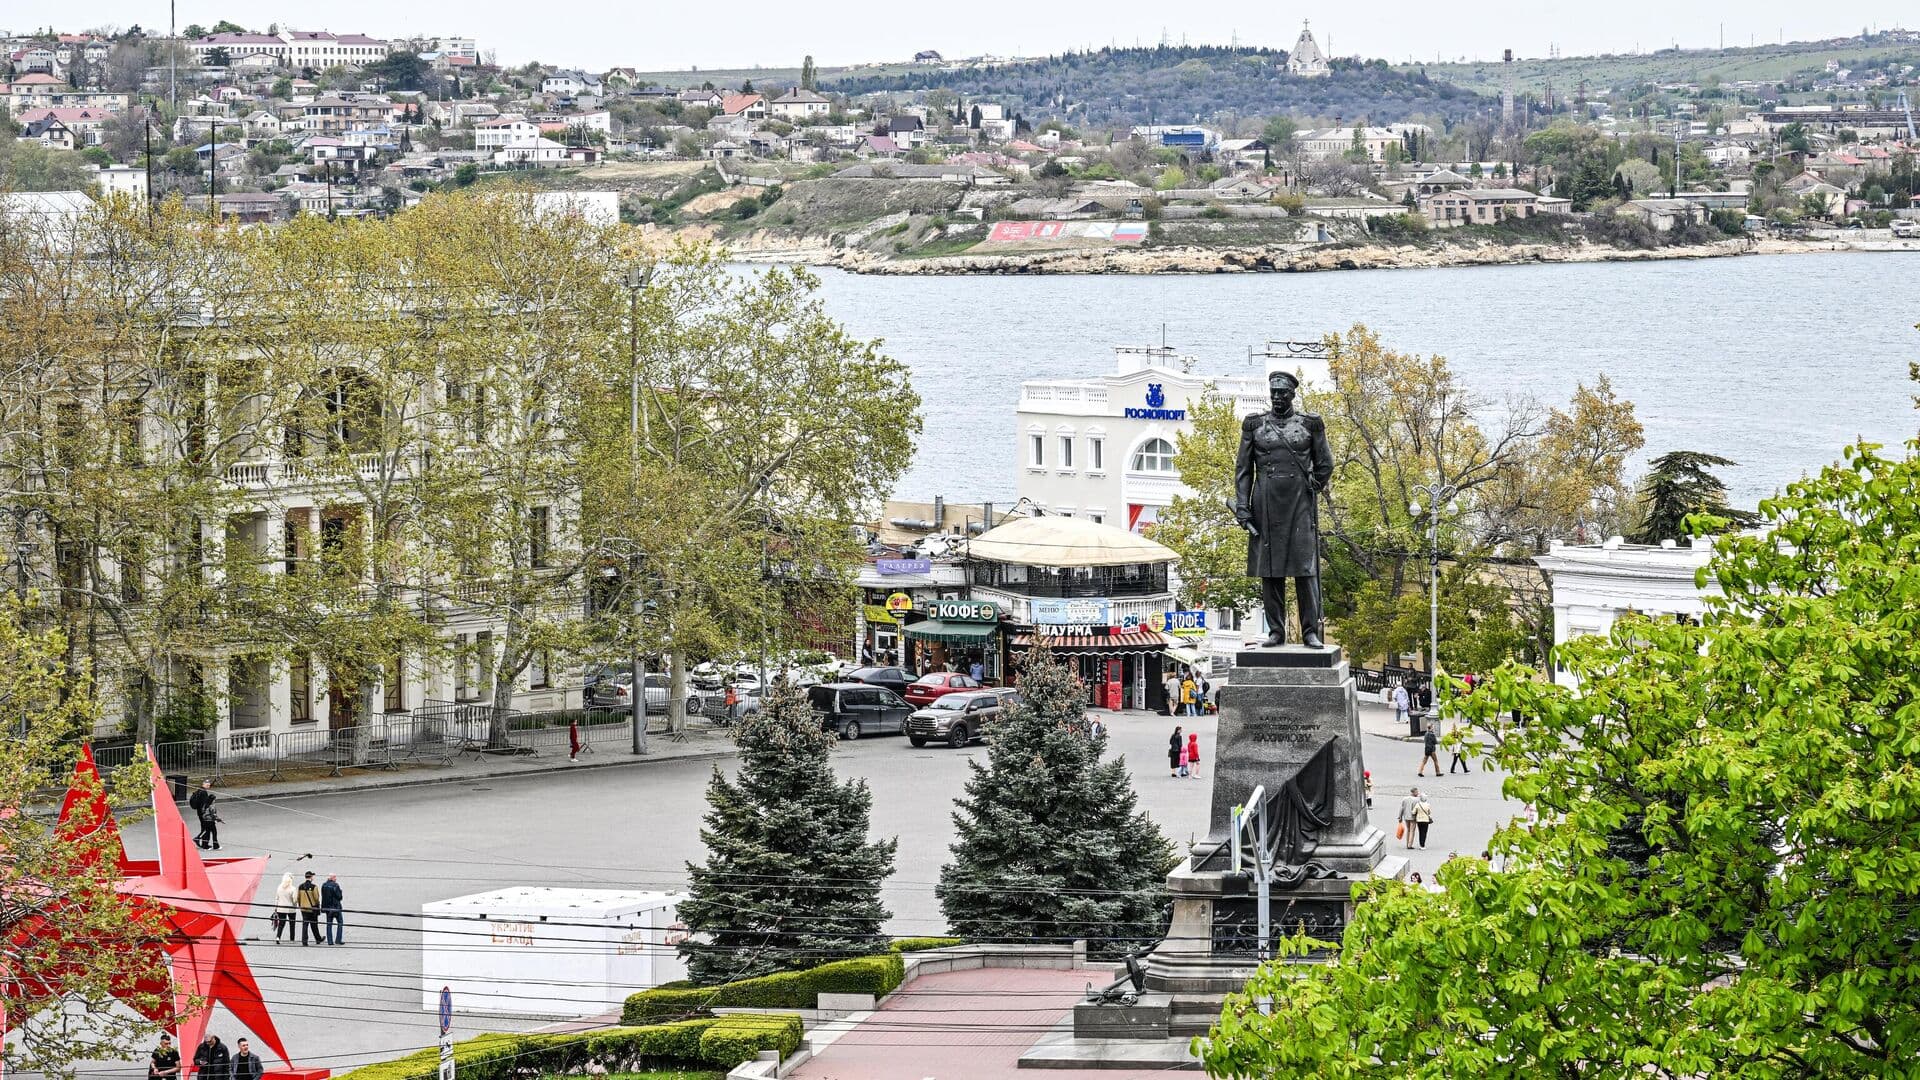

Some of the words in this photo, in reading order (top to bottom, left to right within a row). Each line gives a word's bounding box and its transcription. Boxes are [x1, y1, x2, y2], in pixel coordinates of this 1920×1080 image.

[1125, 408, 1185, 420] РОСМОРПОРТ
[940, 604, 979, 619] КОФЕ
[1123, 616, 1138, 627] 24
[1172, 613, 1200, 628] КОФЕ
[1039, 624, 1093, 636] ШАУРМА
